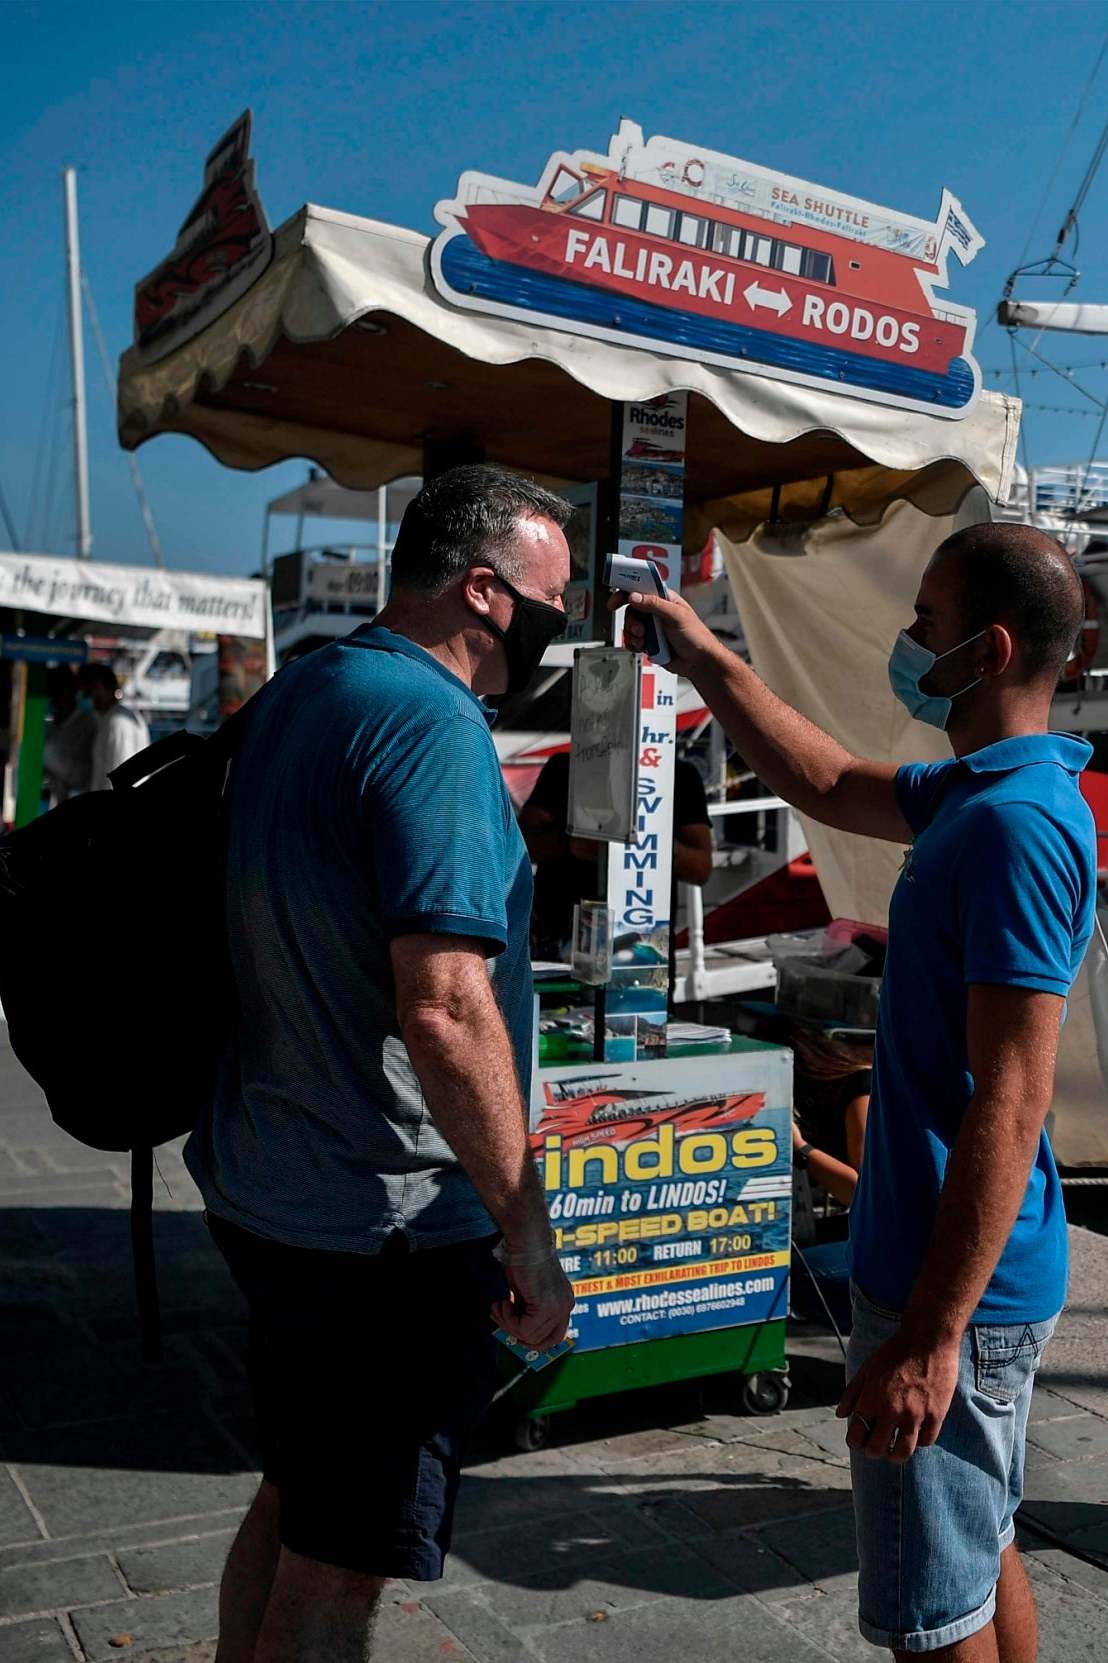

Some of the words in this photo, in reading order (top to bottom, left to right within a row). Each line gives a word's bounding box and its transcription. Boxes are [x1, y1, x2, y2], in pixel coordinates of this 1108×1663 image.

[771, 187, 799, 206] SEA
[804, 199, 870, 228] SHUTTLE
[565, 229, 735, 304] FALIRAKI
[802, 295, 920, 354] RODOS
[630, 407, 685, 430] Rhodes
[13, 566, 45, 594] the
[46, 571, 127, 615] journey
[133, 579, 171, 610] that
[178, 594, 257, 620] matters!
[657, 690, 673, 706] in
[642, 726, 673, 744] hr.
[544, 1124, 778, 1191] indos
[550, 1190, 613, 1219] 60min
[621, 1190, 641, 1212] to
[647, 1179, 727, 1209] LINDOS!
[687, 1201, 776, 1232] BOAT!
[593, 1247, 637, 1266] 11:00
[653, 1240, 702, 1261] RETURN
[709, 1234, 751, 1253] 17:00
[643, 1265, 706, 1284] EXHILARATING
[709, 1262, 730, 1274] TRIP
[732, 1260, 743, 1271] TO
[743, 1255, 776, 1269] LINDOS
[597, 1277, 775, 1318] www.rhodessealines.com
[620, 1311, 667, 1326] CONTACT:
